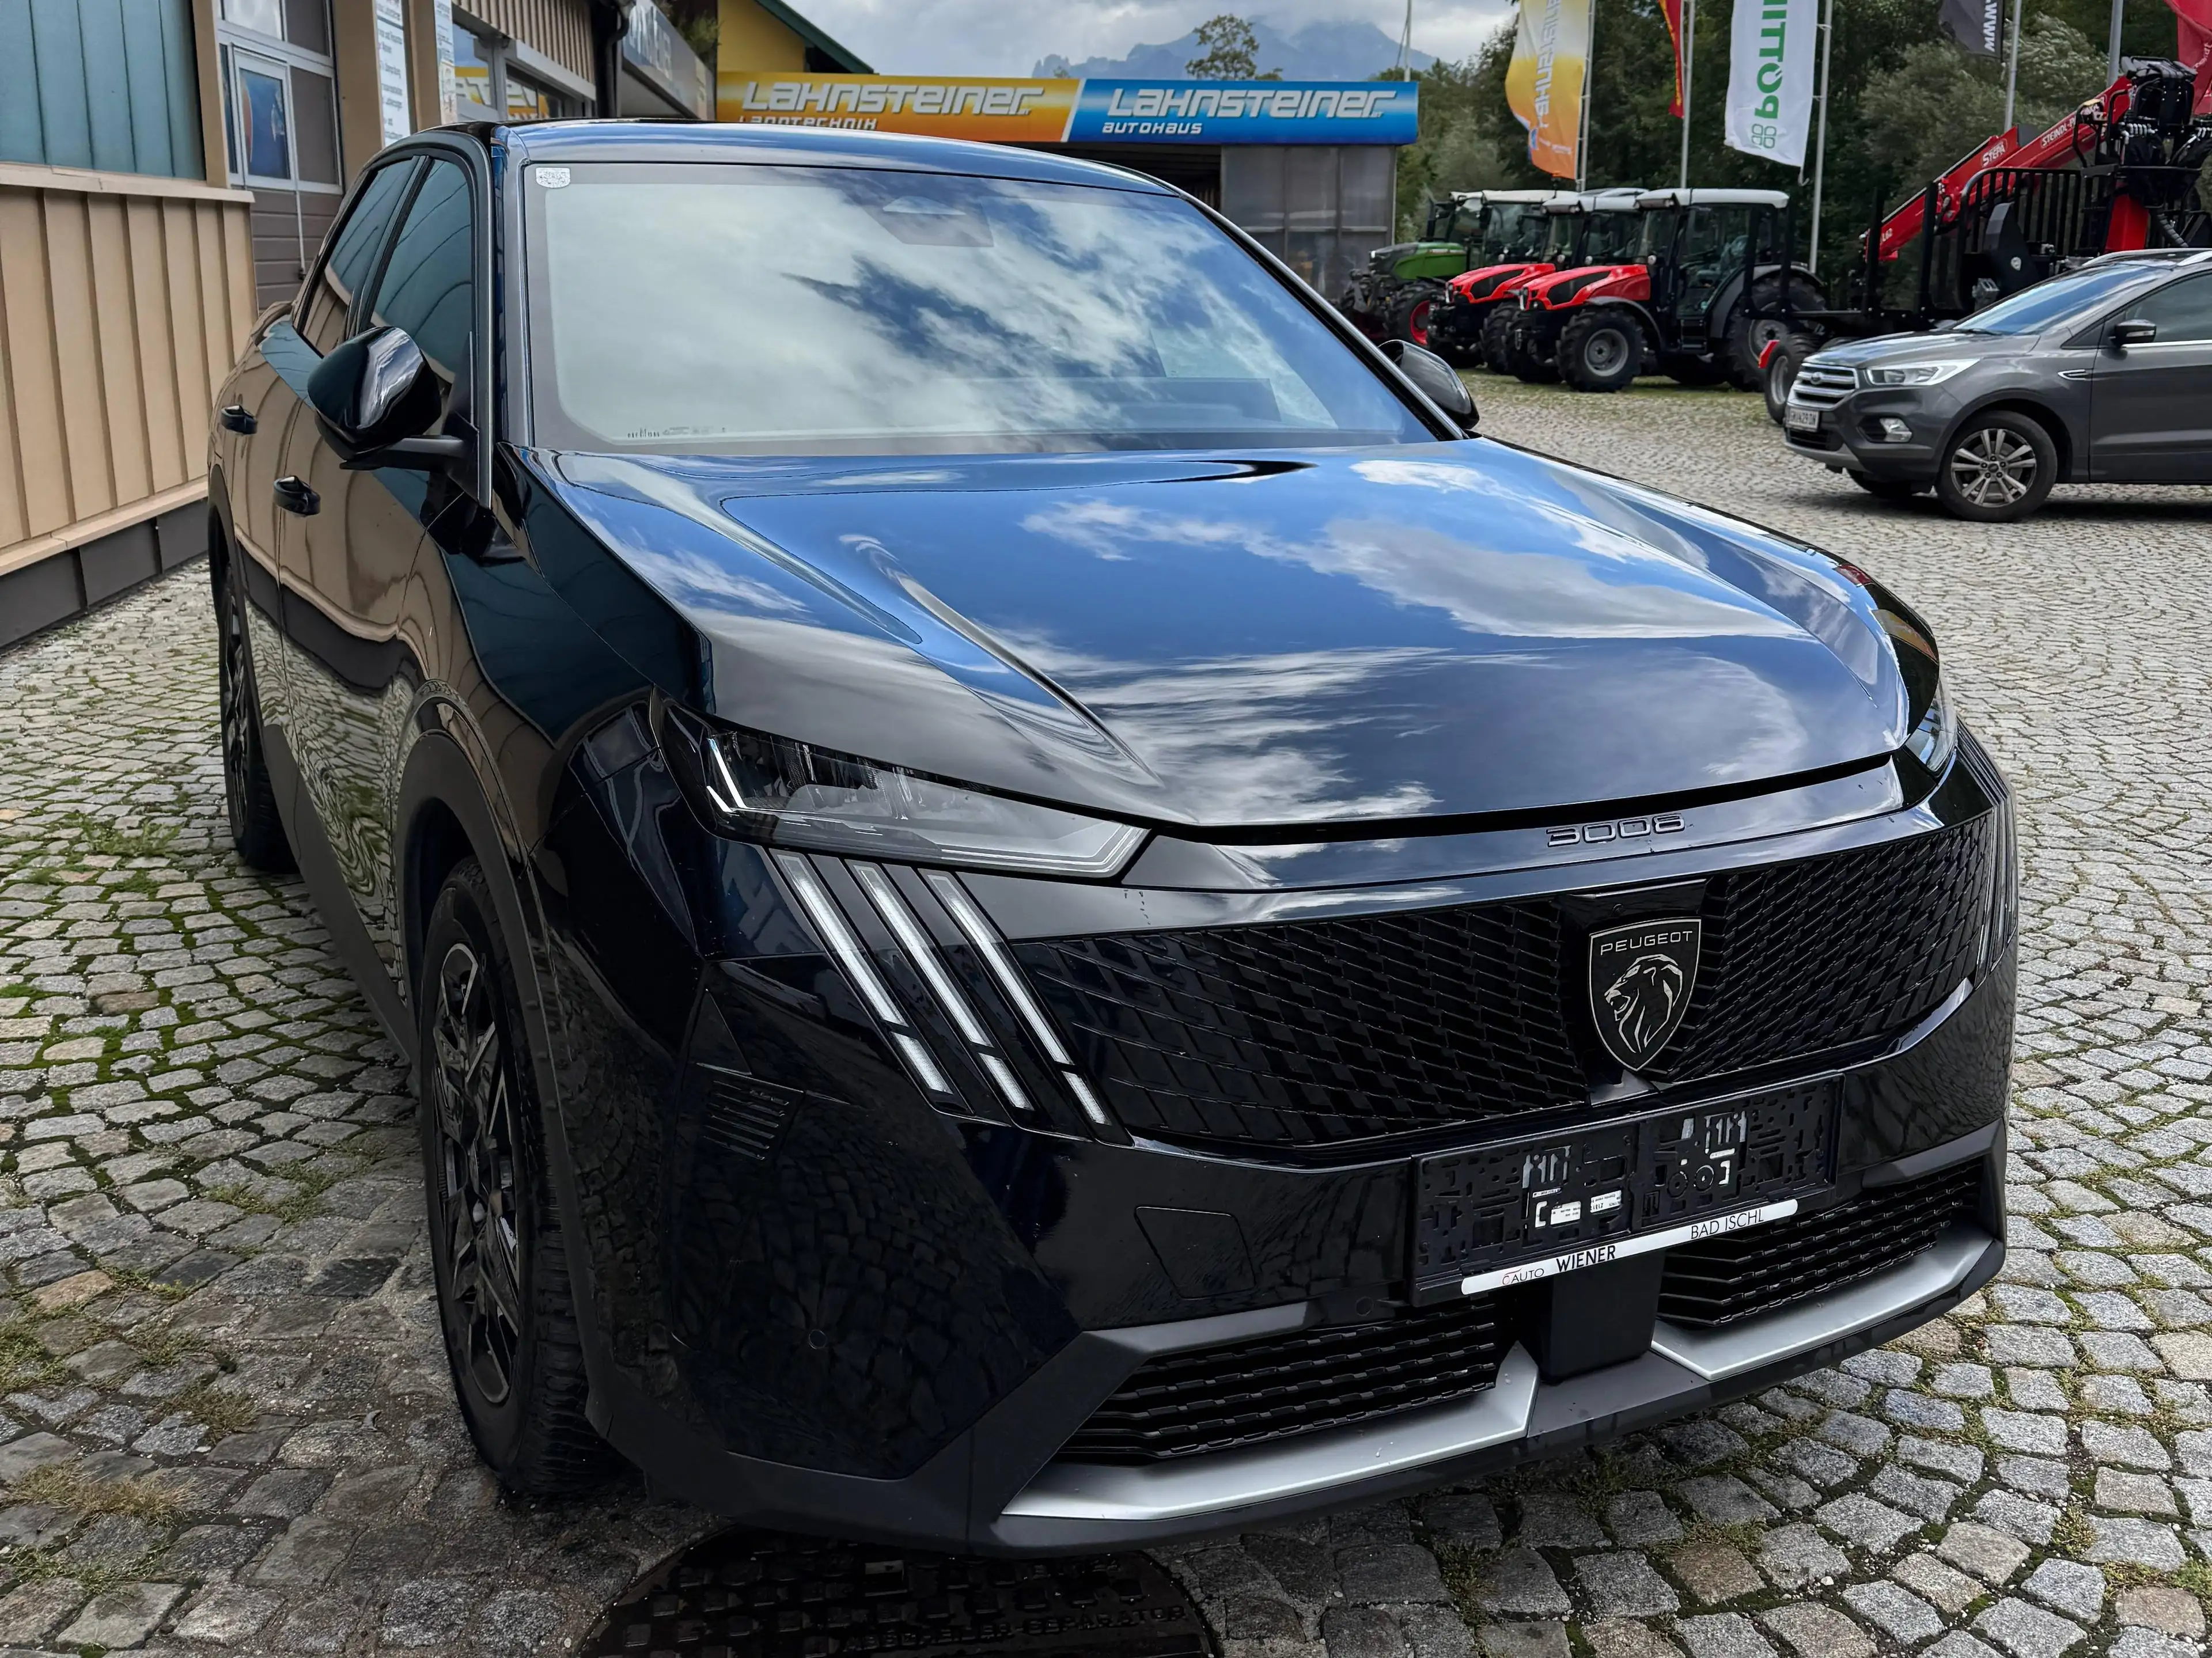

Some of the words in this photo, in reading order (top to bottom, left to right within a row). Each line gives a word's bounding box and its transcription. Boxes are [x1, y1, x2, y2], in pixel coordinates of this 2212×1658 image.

[1546, 813, 1685, 847] 3008
[1600, 931, 1693, 955] PEUGEOT
[1556, 1245, 1616, 1273] WIENER
[1691, 1220, 1720, 1239] BAD
[1725, 1208, 1764, 1231] ISCHL
